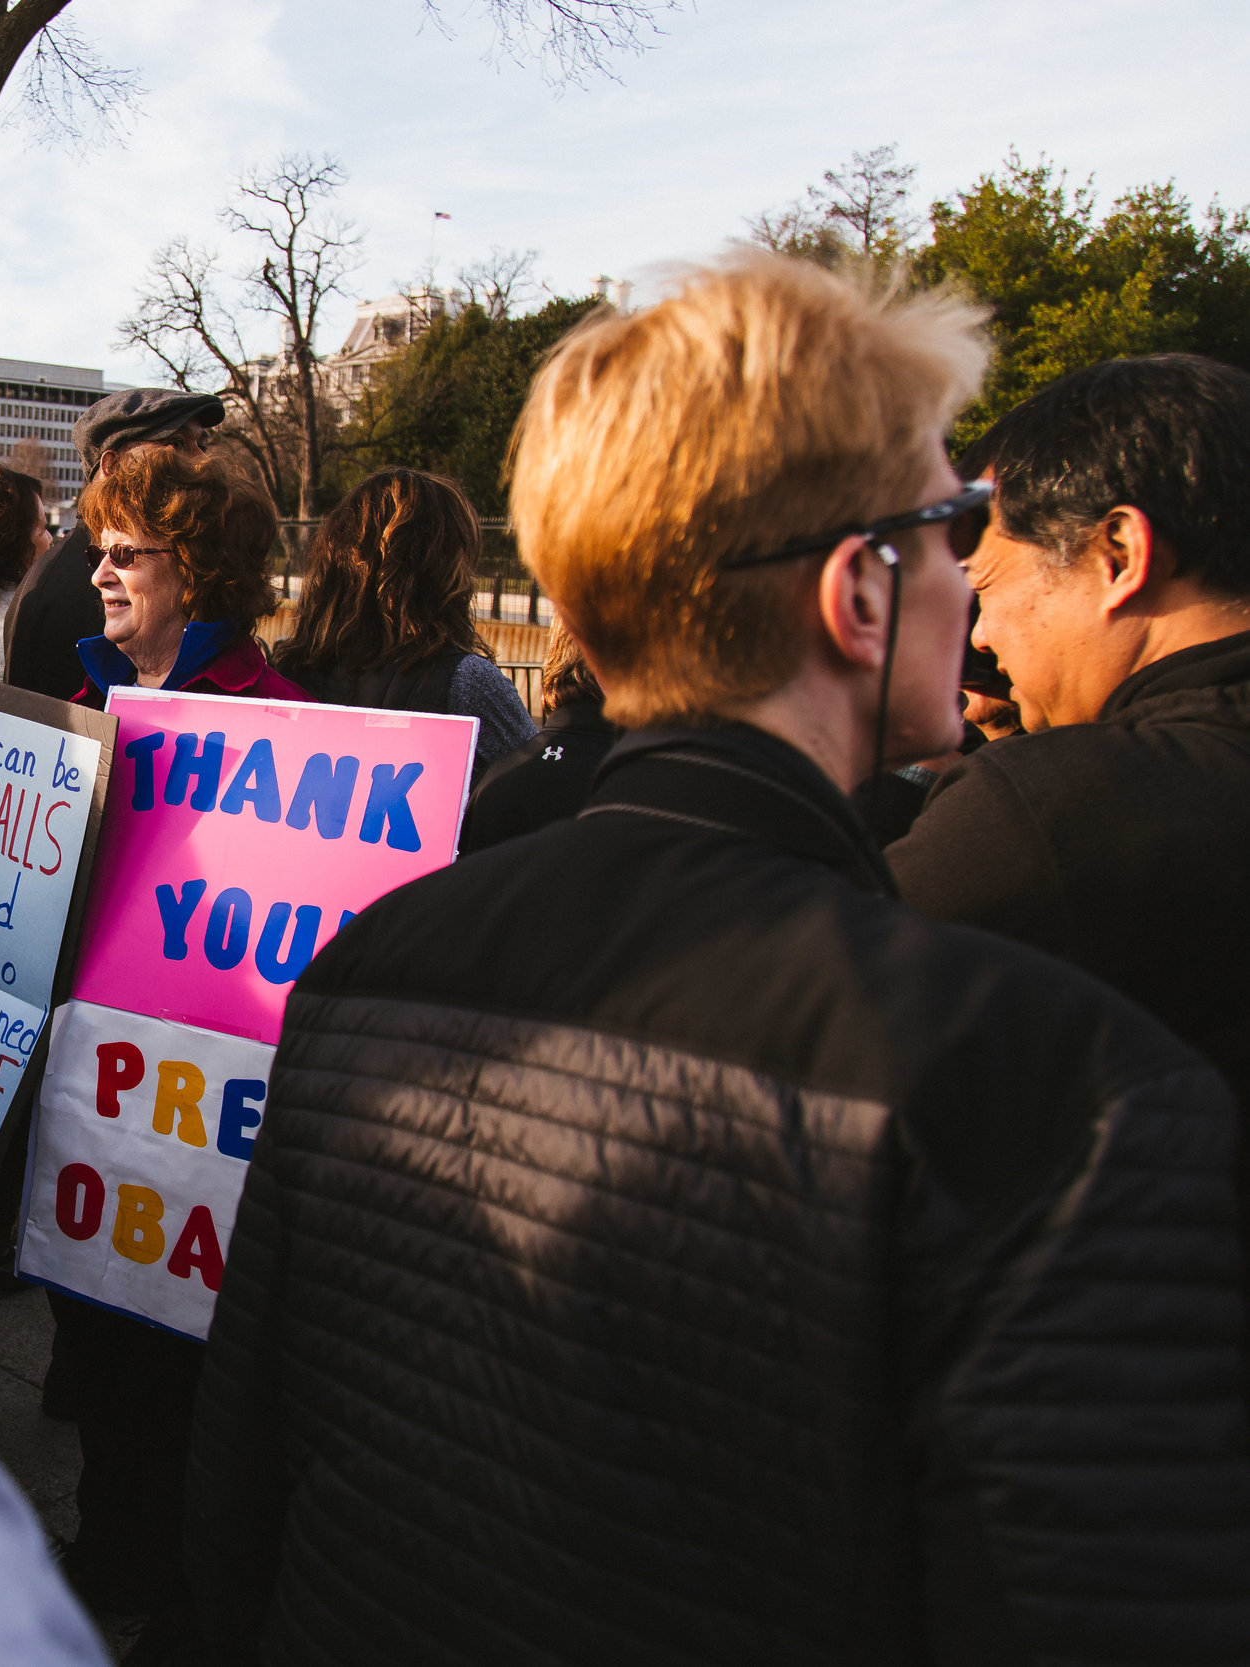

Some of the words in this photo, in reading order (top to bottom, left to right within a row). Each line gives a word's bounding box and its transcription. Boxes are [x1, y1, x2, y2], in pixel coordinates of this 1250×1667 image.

[52, 737, 81, 792] be
[124, 731, 425, 853] THANK
[155, 878, 357, 986] YOU
[95, 1040, 267, 1162] PRE
[55, 1162, 225, 1293] OBA
